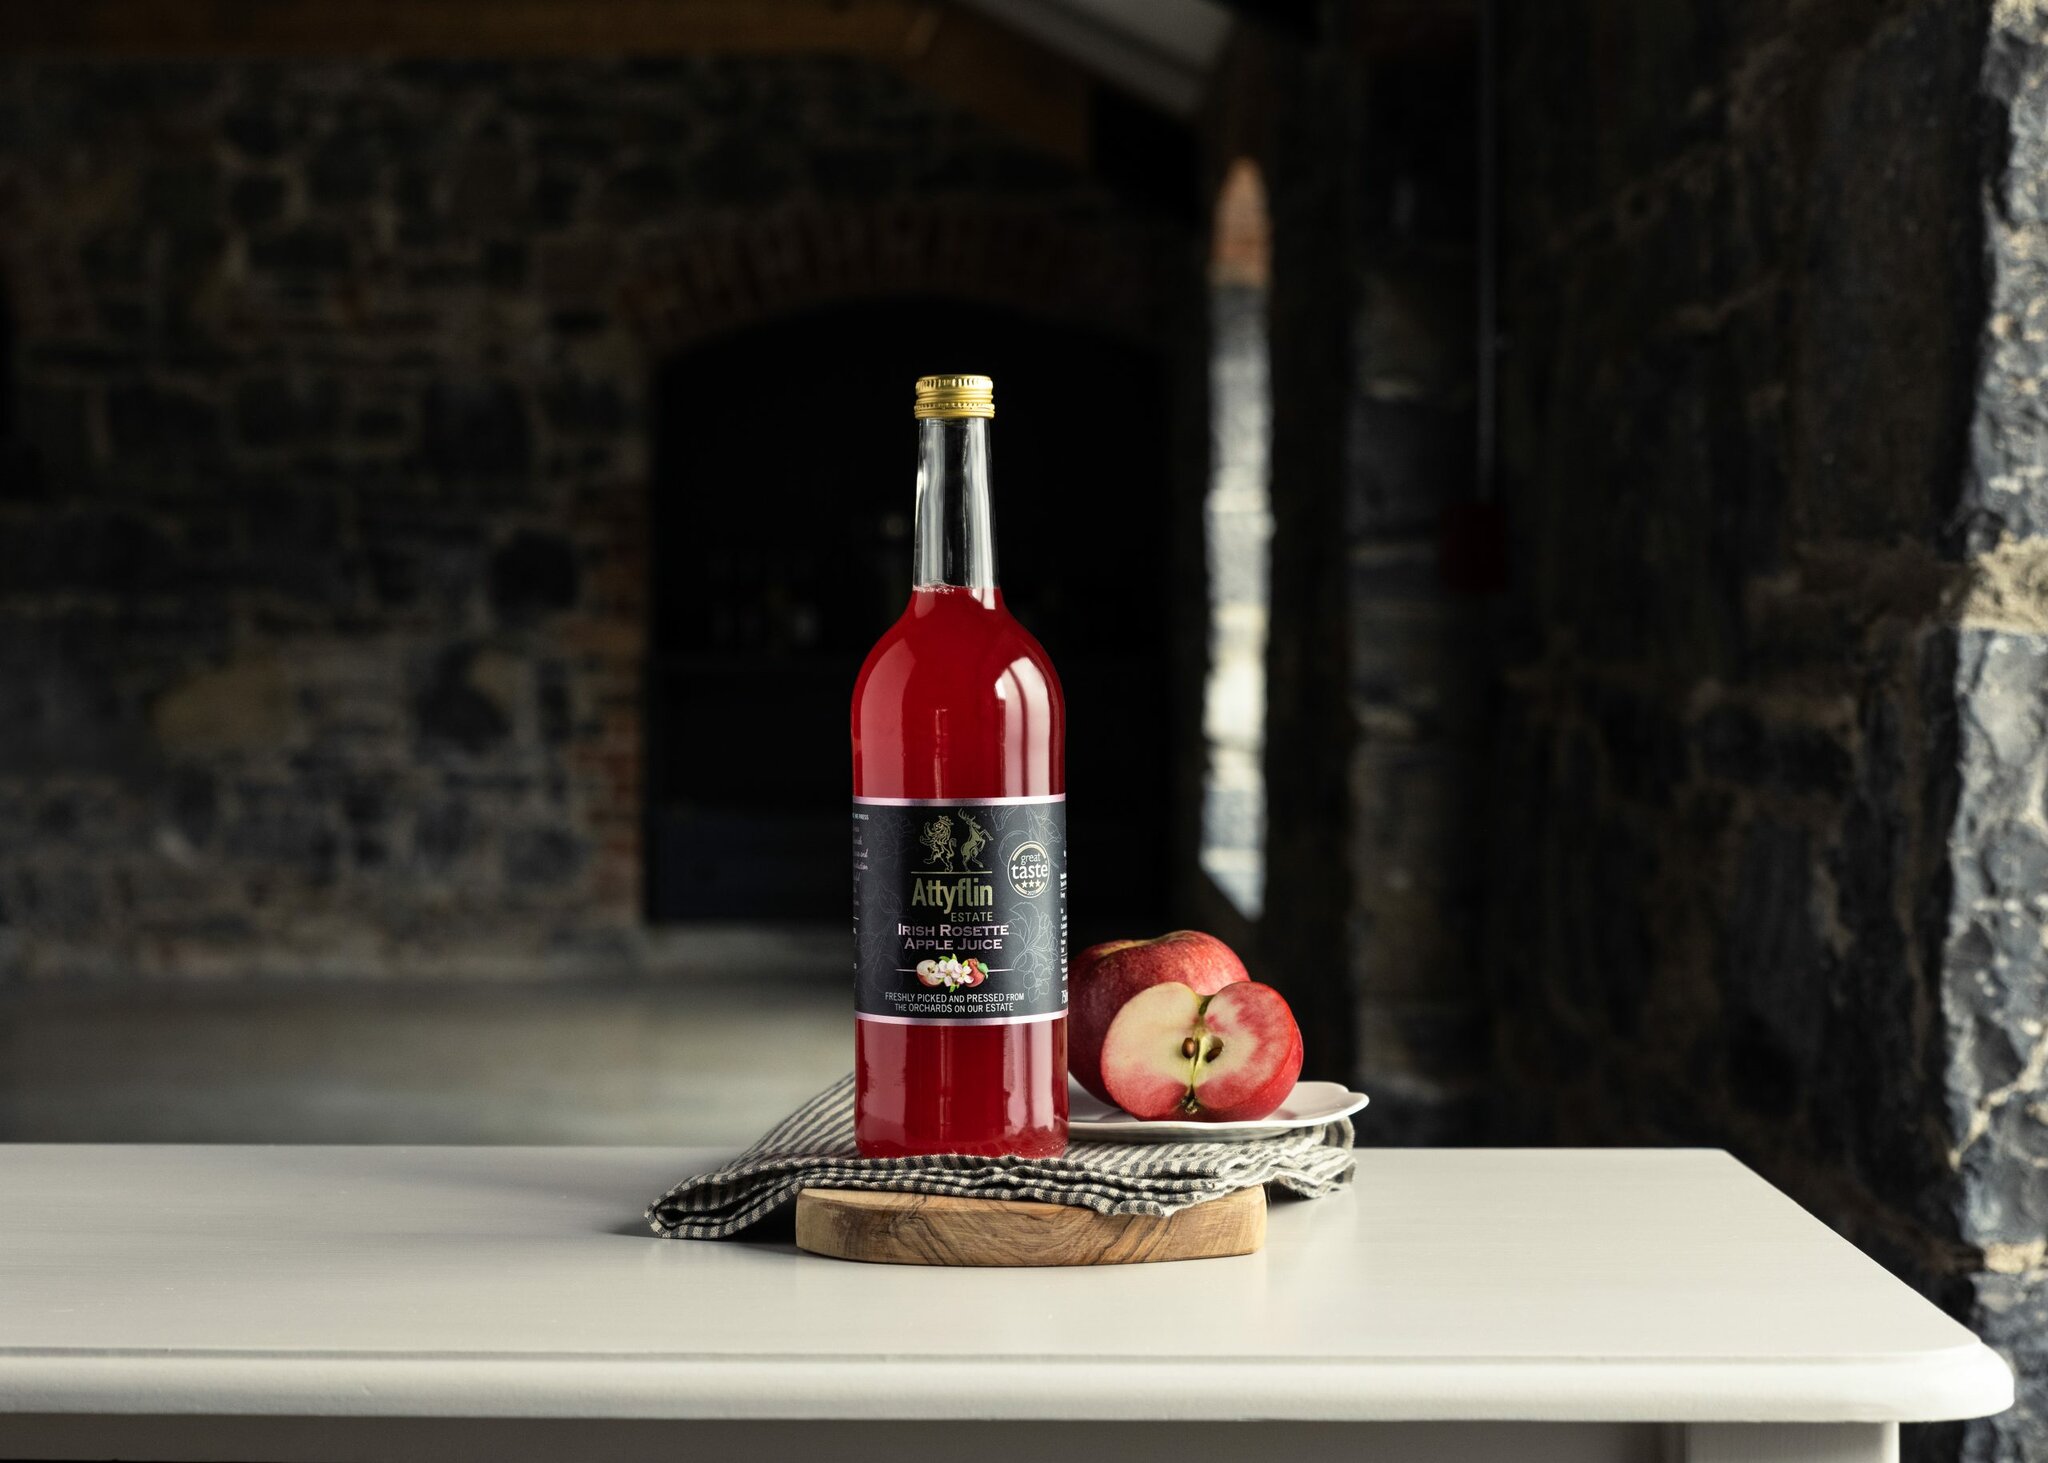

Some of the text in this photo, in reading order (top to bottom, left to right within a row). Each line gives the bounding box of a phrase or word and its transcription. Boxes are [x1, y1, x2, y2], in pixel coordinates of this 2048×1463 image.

[1021, 853, 1041, 866] great
[1011, 863, 1048, 879] taste
[911, 877, 993, 915] Attyflin
[950, 911, 994, 922] ESTATE
[898, 923, 1009, 937] IRISH ROSETTE
[904, 937, 1003, 950] APPLE JUICE
[885, 991, 1025, 1003] FRESHLY PICKED AND PRESSED FROM
[895, 1002, 1014, 1013] THE ORCHARDS ON OUR ESTATE
